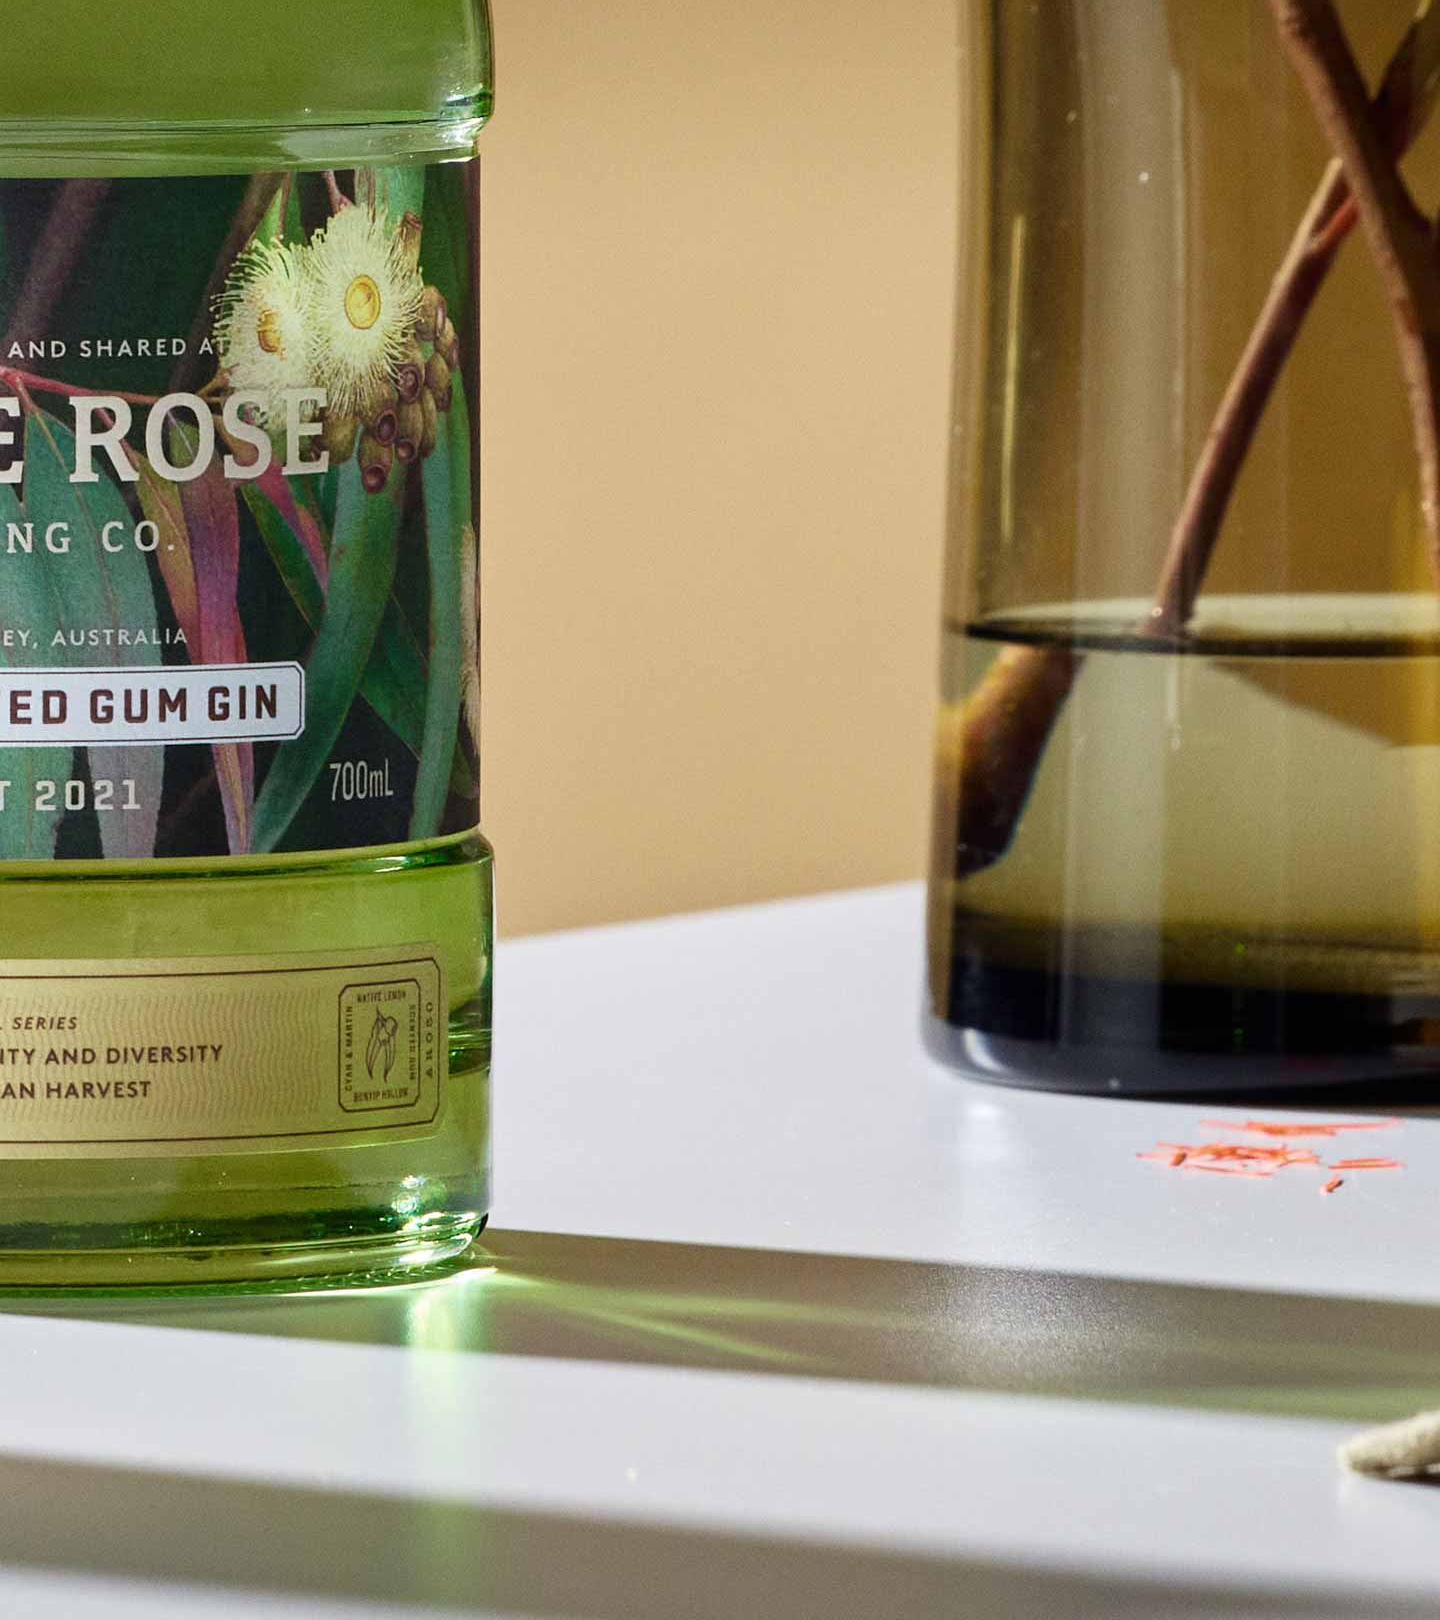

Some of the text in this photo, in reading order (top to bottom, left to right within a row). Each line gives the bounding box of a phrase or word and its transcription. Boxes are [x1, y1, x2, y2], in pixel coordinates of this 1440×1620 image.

[7, 340, 67, 359] AND
[79, 338, 187, 358] SHARED
[198, 336, 228, 356] AT
[68, 386, 330, 483] ROSE
[101, 519, 176, 553] CO.
[50, 626, 188, 647] AUSTRALIA
[89, 687, 188, 725] GUM
[207, 683, 278, 722] GIN
[329, 757, 394, 802] 700mL
[34, 778, 142, 812] 2021
[11, 1016, 79, 1030] SERIES
[45, 1048, 97, 1065] AND
[106, 1044, 223, 1064] DIVERSITY
[46, 1081, 152, 1099] HARVEST
